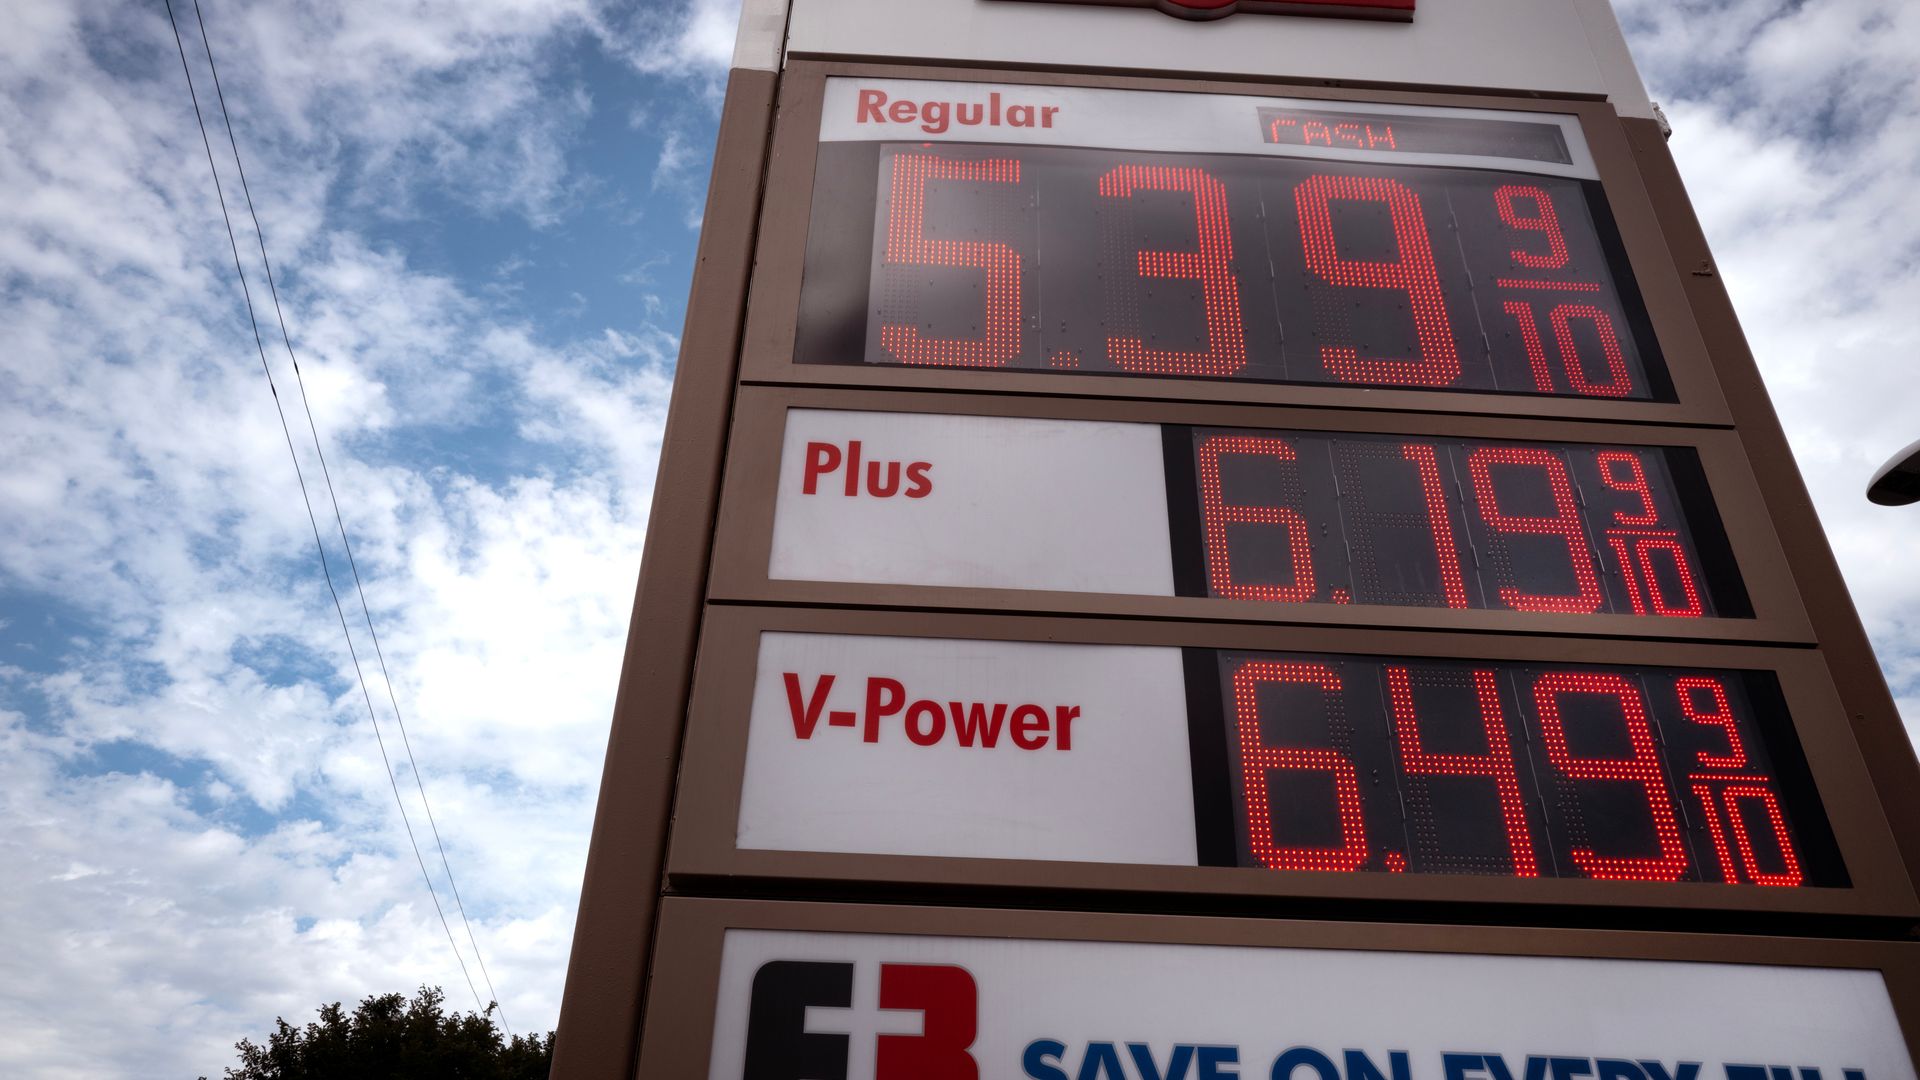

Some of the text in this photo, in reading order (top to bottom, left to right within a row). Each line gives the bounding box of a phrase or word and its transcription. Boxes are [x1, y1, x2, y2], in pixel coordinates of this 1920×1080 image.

[857, 89, 1059, 134] Regular
[1270, 118, 1397, 150] CASH
[802, 440, 933, 499] Plus
[1199, 435, 1602, 615] 6.19
[783, 671, 1082, 752] V-Power
[1231, 660, 1691, 884] 6.49
